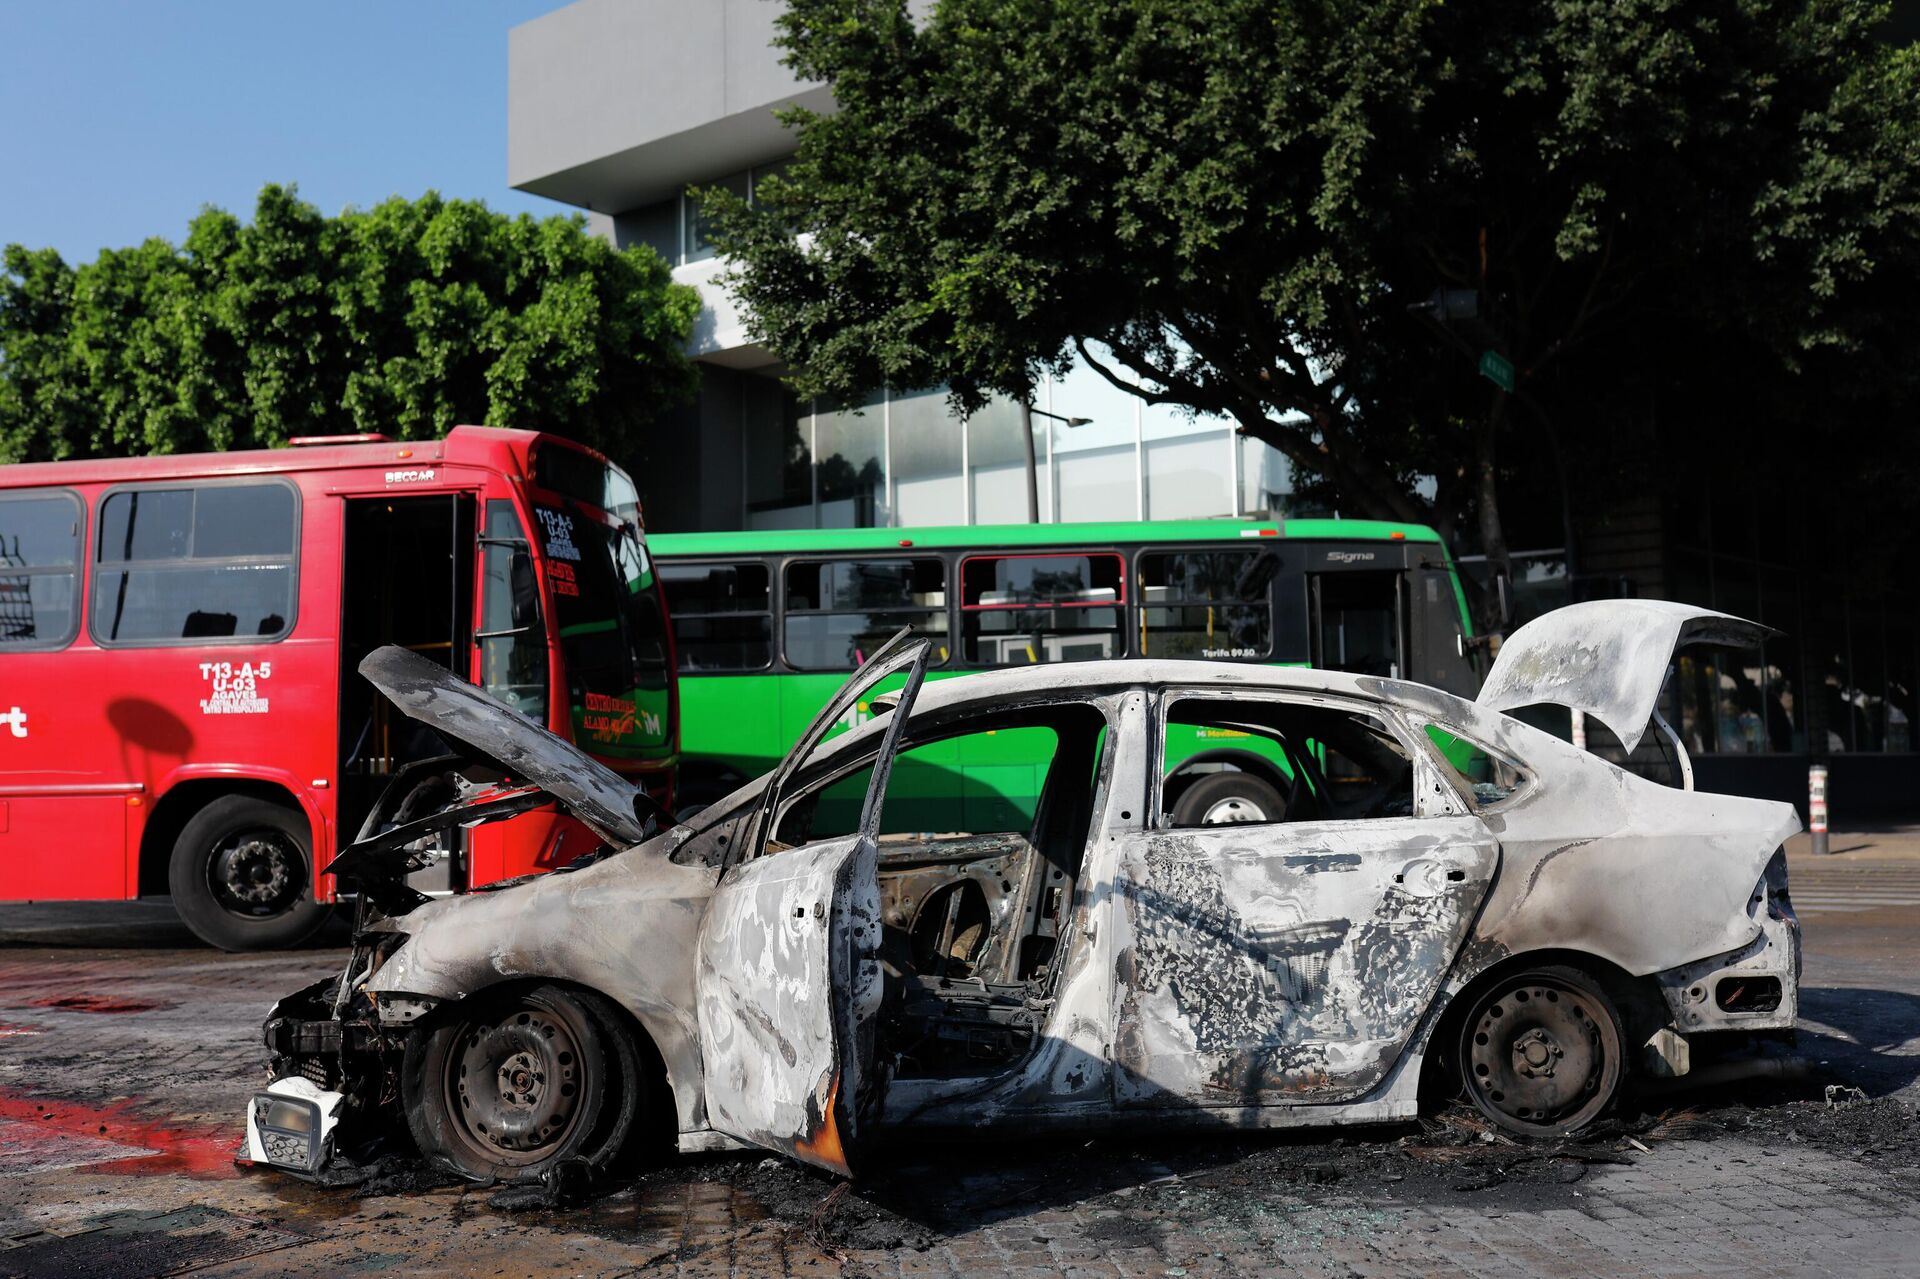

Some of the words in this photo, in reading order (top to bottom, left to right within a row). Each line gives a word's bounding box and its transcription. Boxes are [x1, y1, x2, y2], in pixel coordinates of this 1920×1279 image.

[385, 470, 435, 483] BECCAR
[1327, 551, 1375, 563] Sigma
[1202, 649, 1230, 658] Tarifa
[213, 678, 256, 692] U-03
[211, 690, 257, 700] AGAVES
